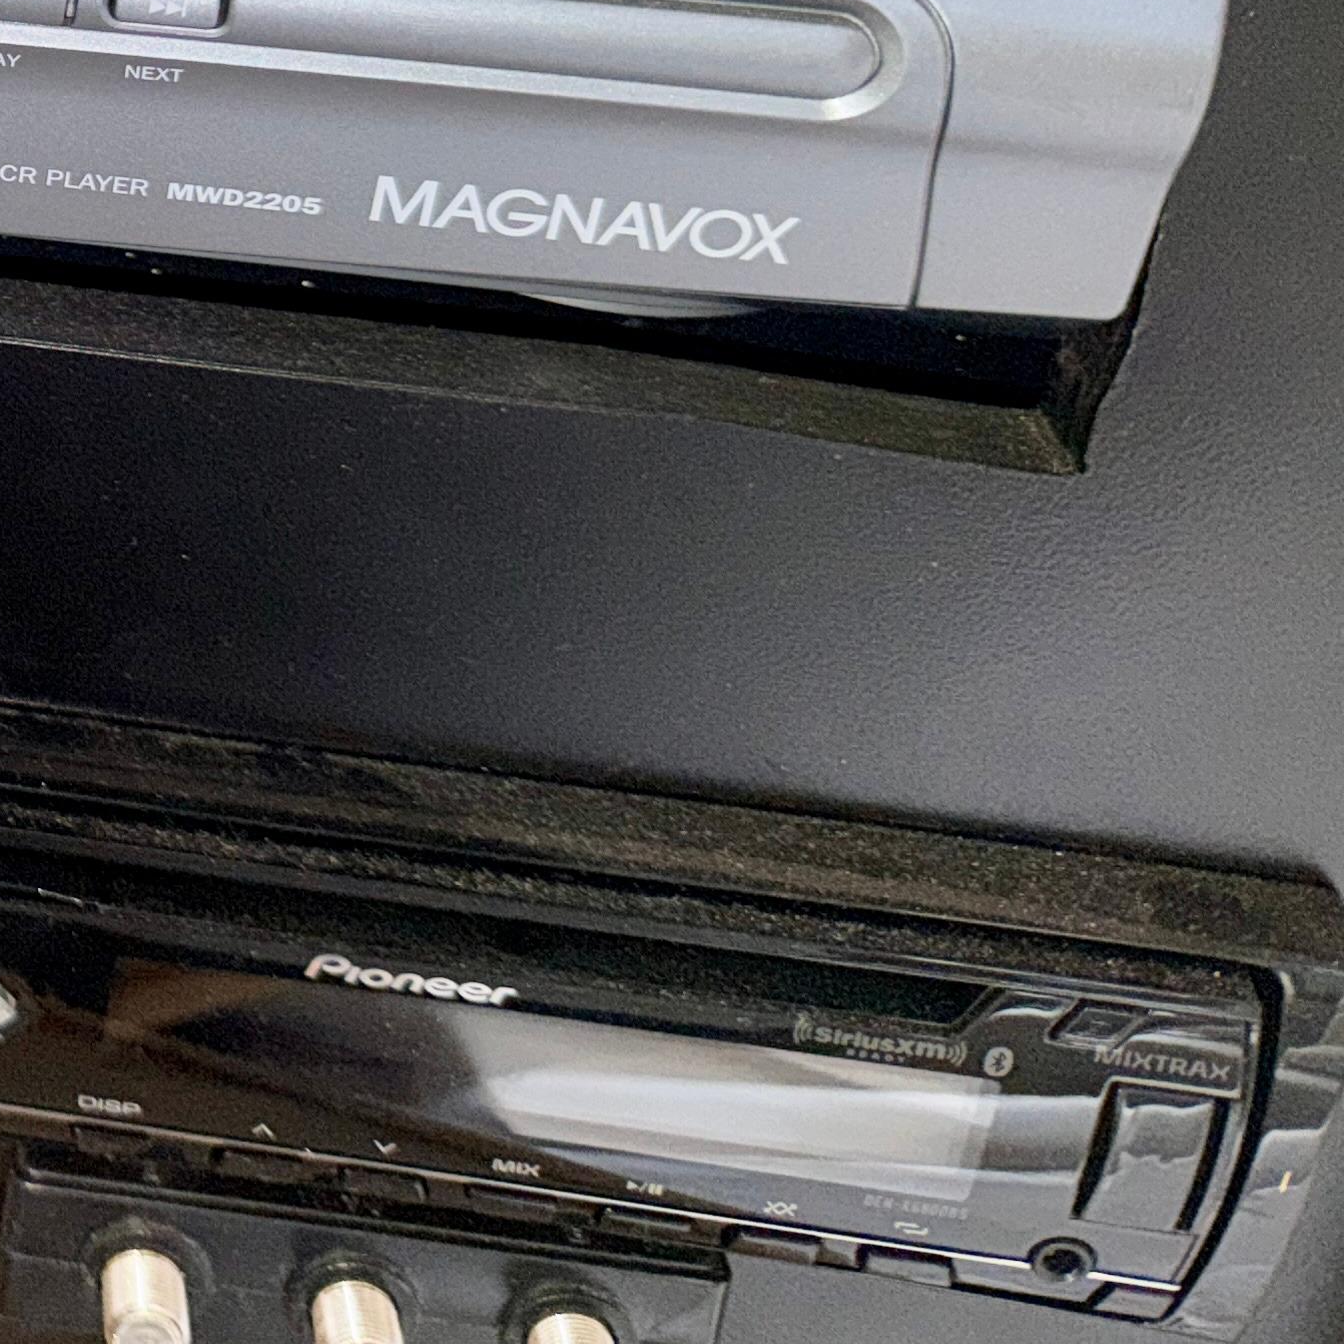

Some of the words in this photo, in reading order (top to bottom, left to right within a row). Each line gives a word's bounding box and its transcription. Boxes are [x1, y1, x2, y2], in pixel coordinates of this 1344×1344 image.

[124, 62, 185, 84] NEXT
[45, 168, 150, 198] PLAYER
[166, 181, 322, 216] MWD2205
[368, 174, 802, 265] MAGNAVOX
[305, 954, 519, 1006] Pioneer
[1094, 1047, 1232, 1081] MIXTRAX
[76, 1093, 144, 1119] DISP
[492, 1158, 541, 1180] MIX
